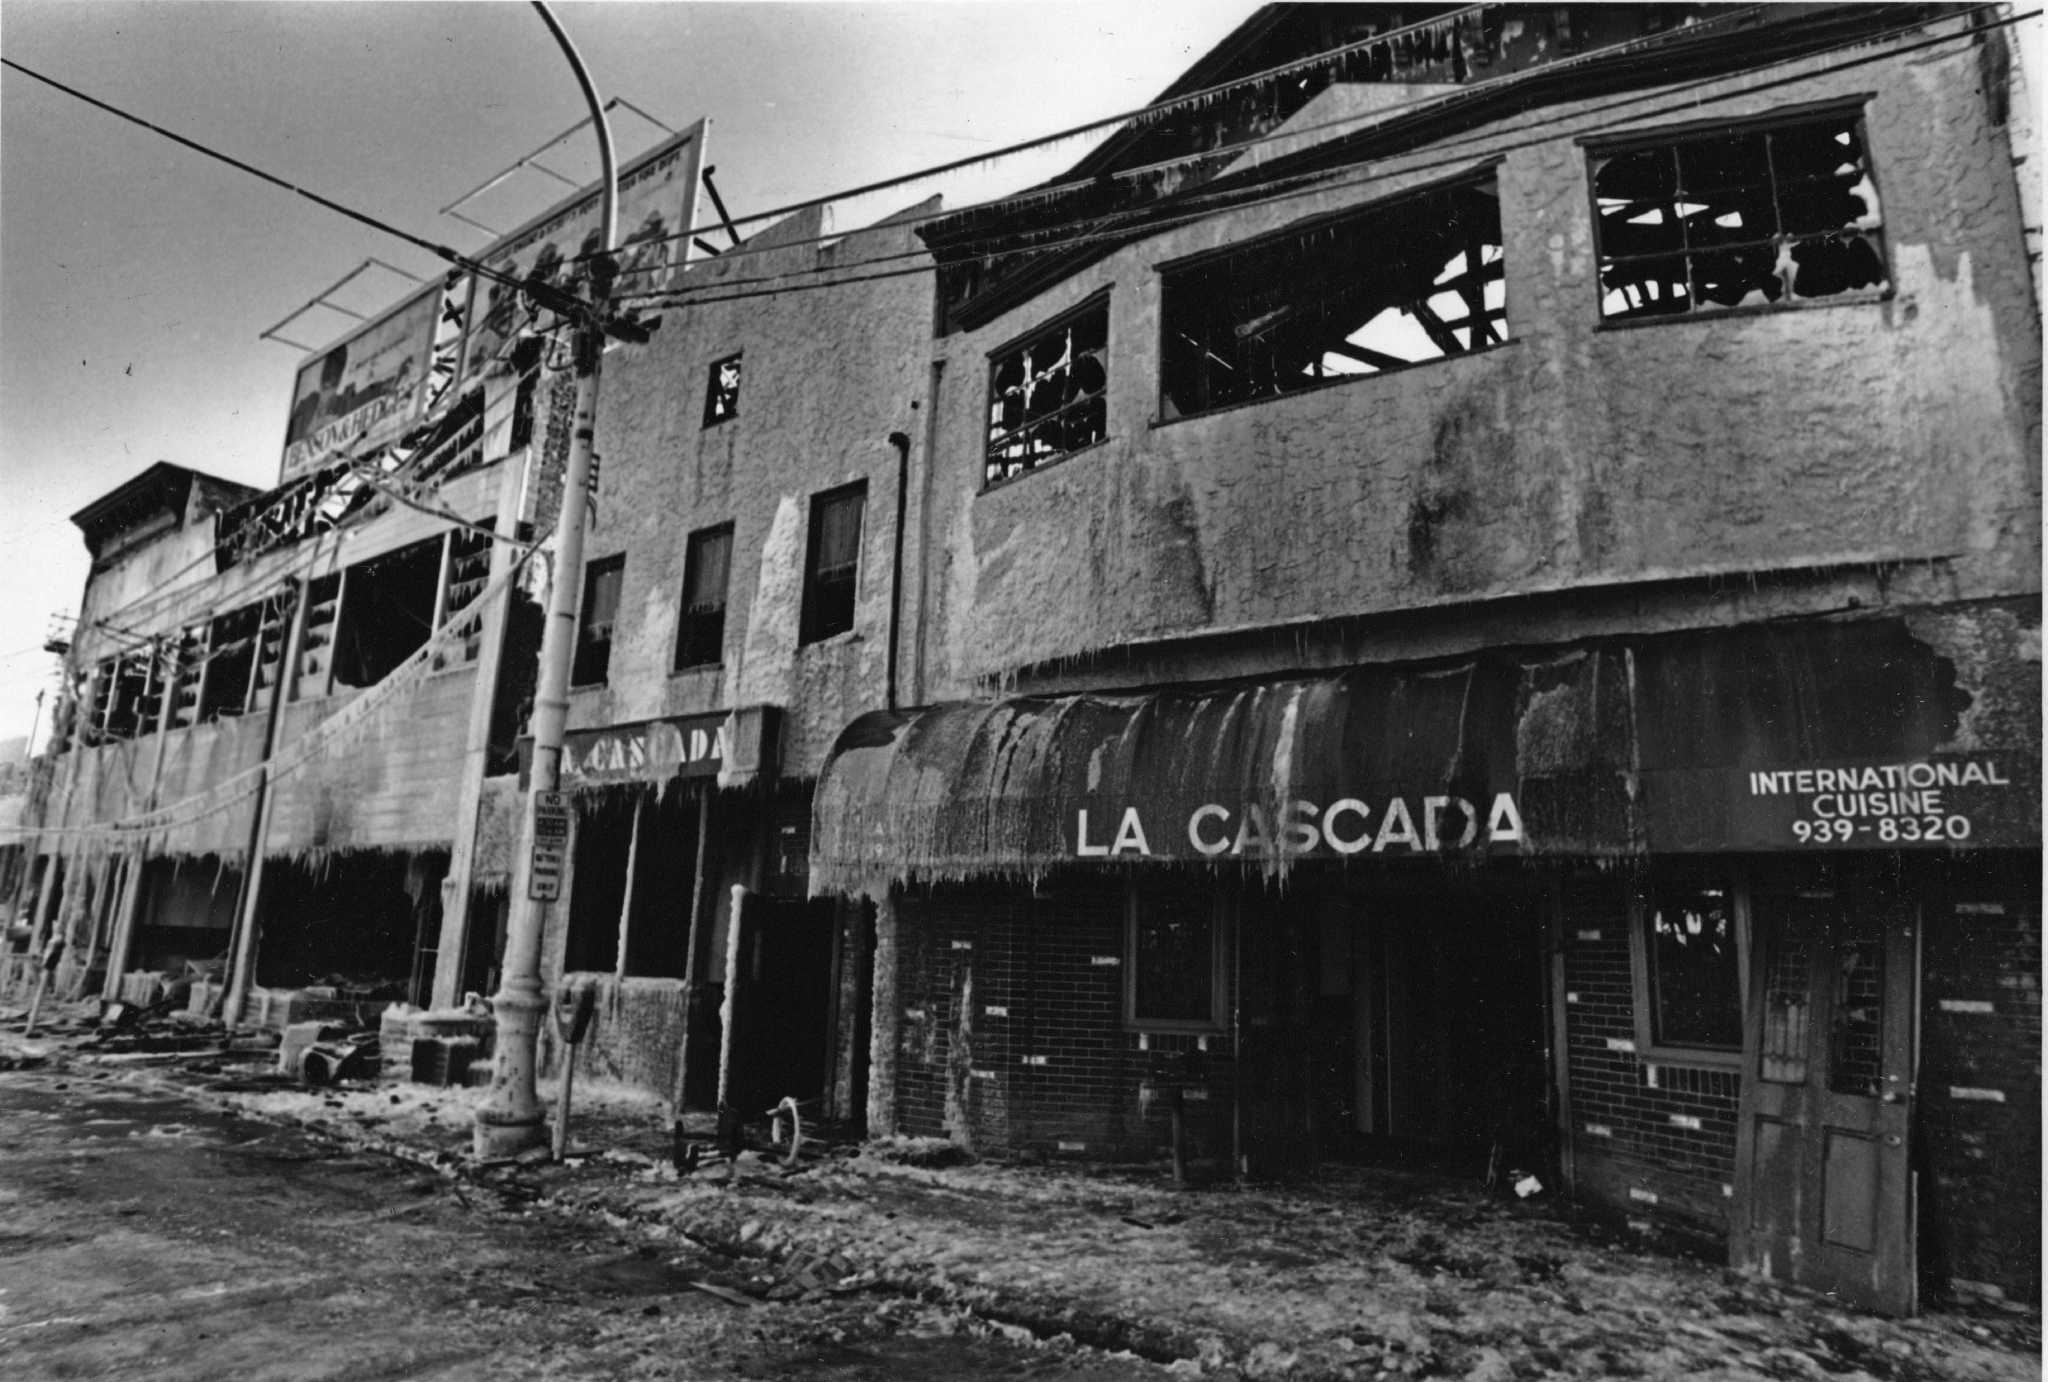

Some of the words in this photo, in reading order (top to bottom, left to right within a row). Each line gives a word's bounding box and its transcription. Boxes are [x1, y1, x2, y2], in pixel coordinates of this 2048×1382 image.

[1750, 761, 2010, 795] INTERNATIONAL
[1812, 790, 1944, 818] CUISINE
[1077, 806, 1151, 856] LA
[1792, 815, 1970, 843] 939-8320
